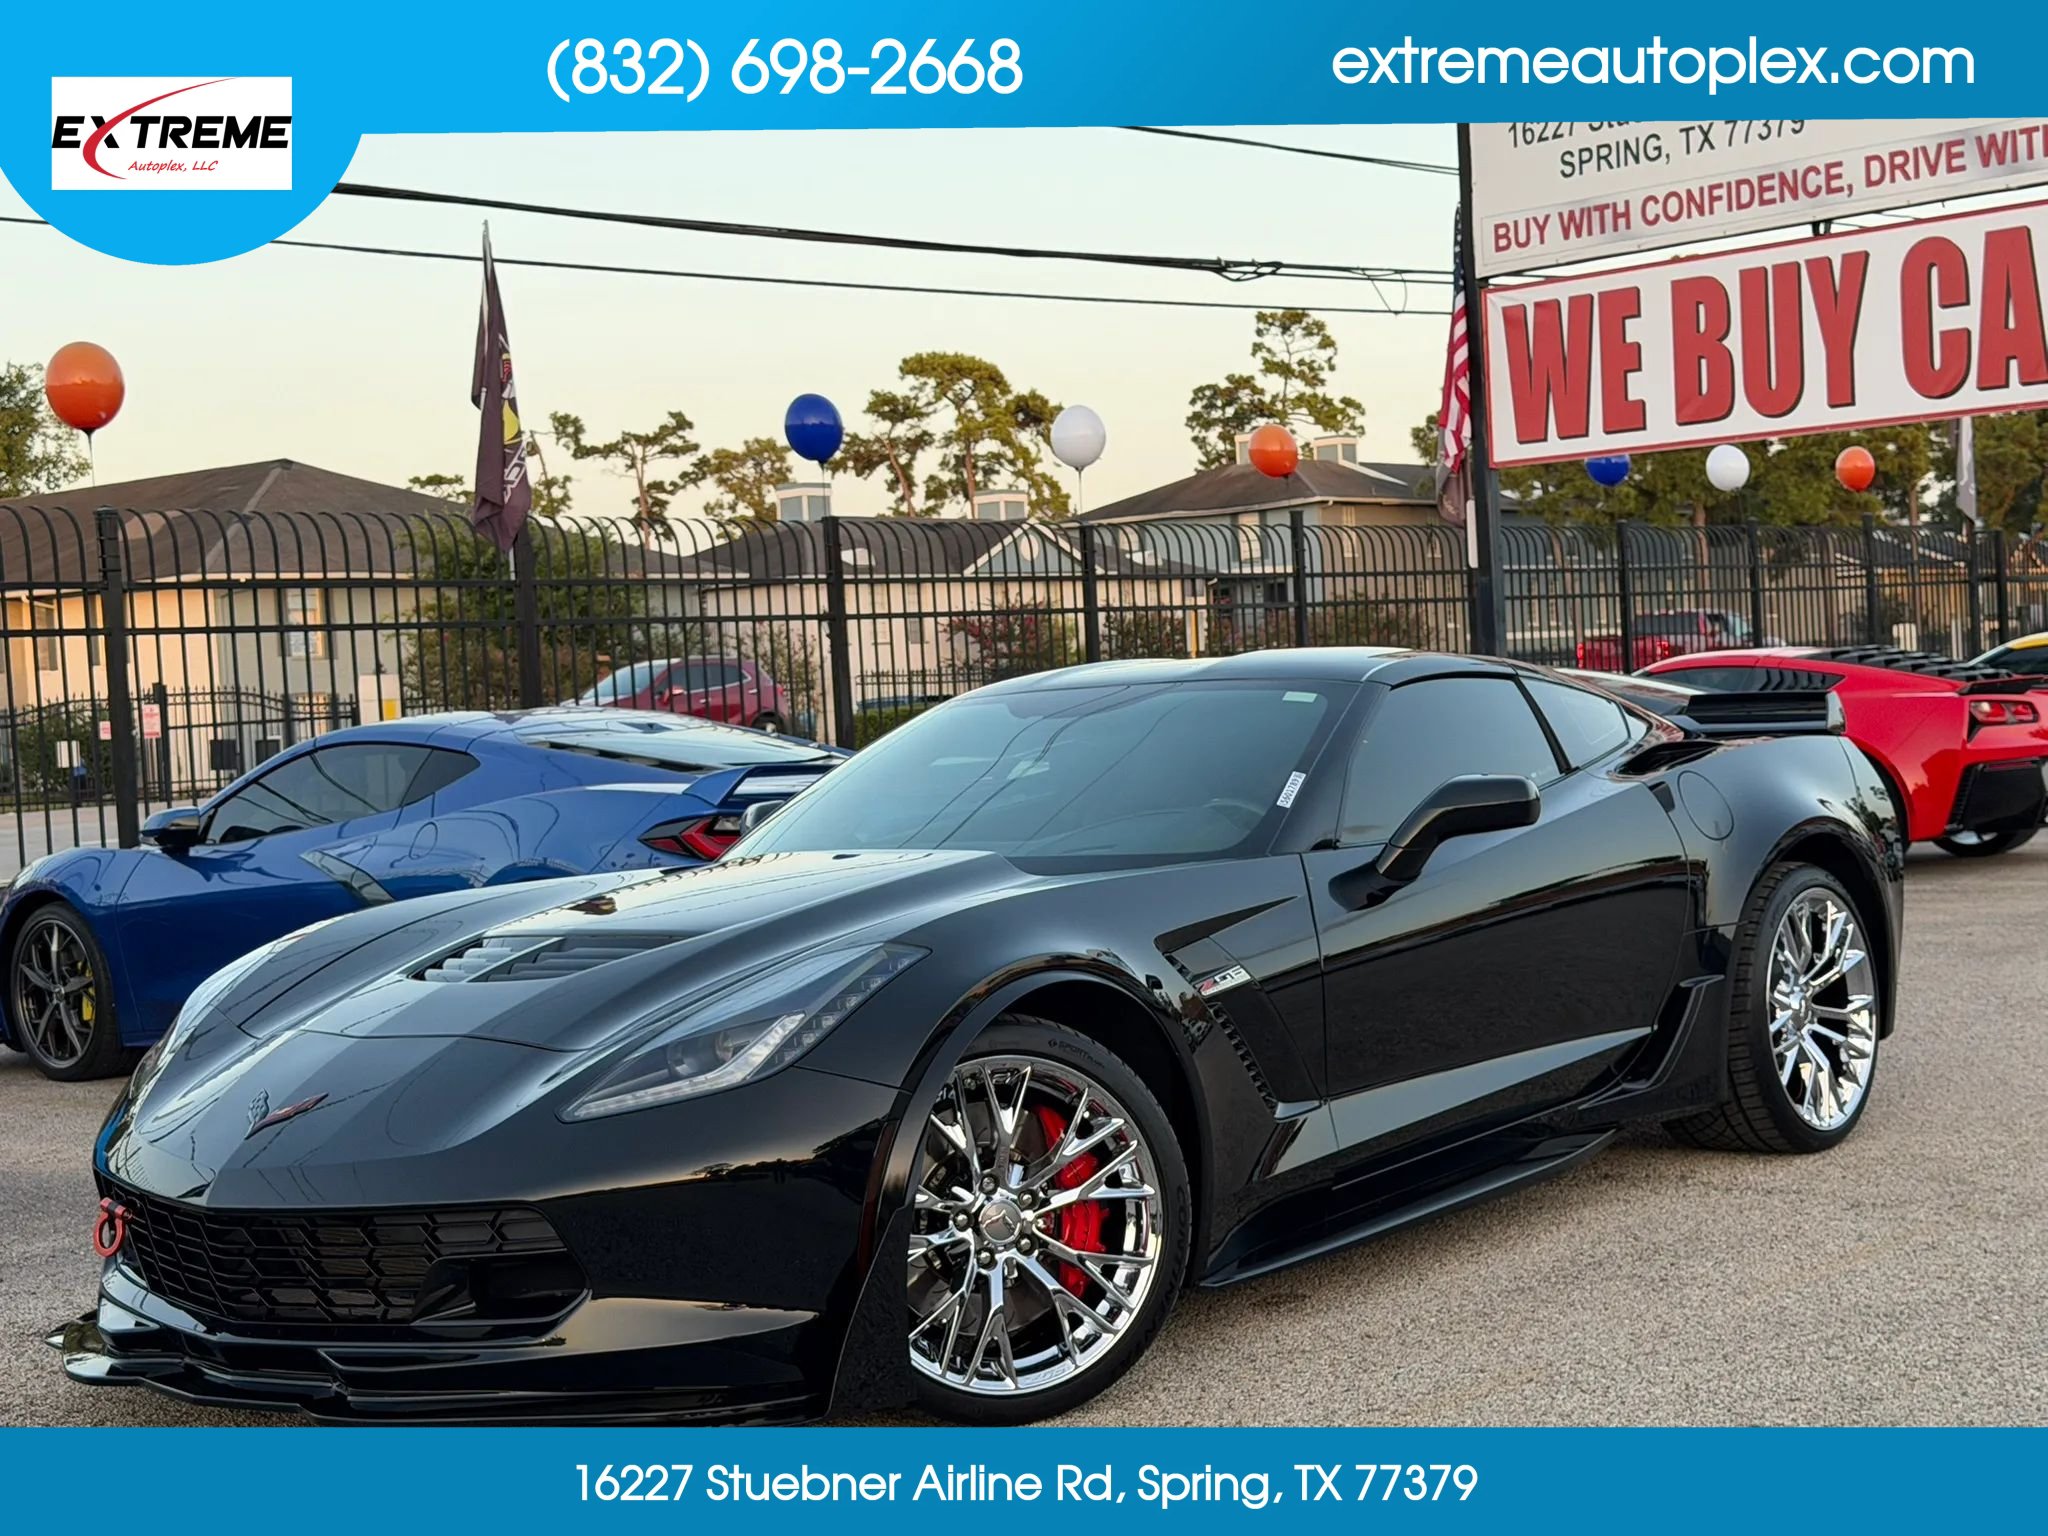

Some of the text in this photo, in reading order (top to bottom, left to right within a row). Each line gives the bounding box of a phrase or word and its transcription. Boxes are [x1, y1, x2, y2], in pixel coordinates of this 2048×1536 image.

[1493, 214, 1551, 253] BUY
[1558, 199, 1632, 241] WITH
[1640, 160, 1854, 227] CONFIDENCE,
[1863, 138, 1967, 188] DRIVE
[1560, 133, 1670, 178] SPRING,
[1679, 121, 1716, 155] TX
[1502, 225, 2048, 445] WE BUY CA
